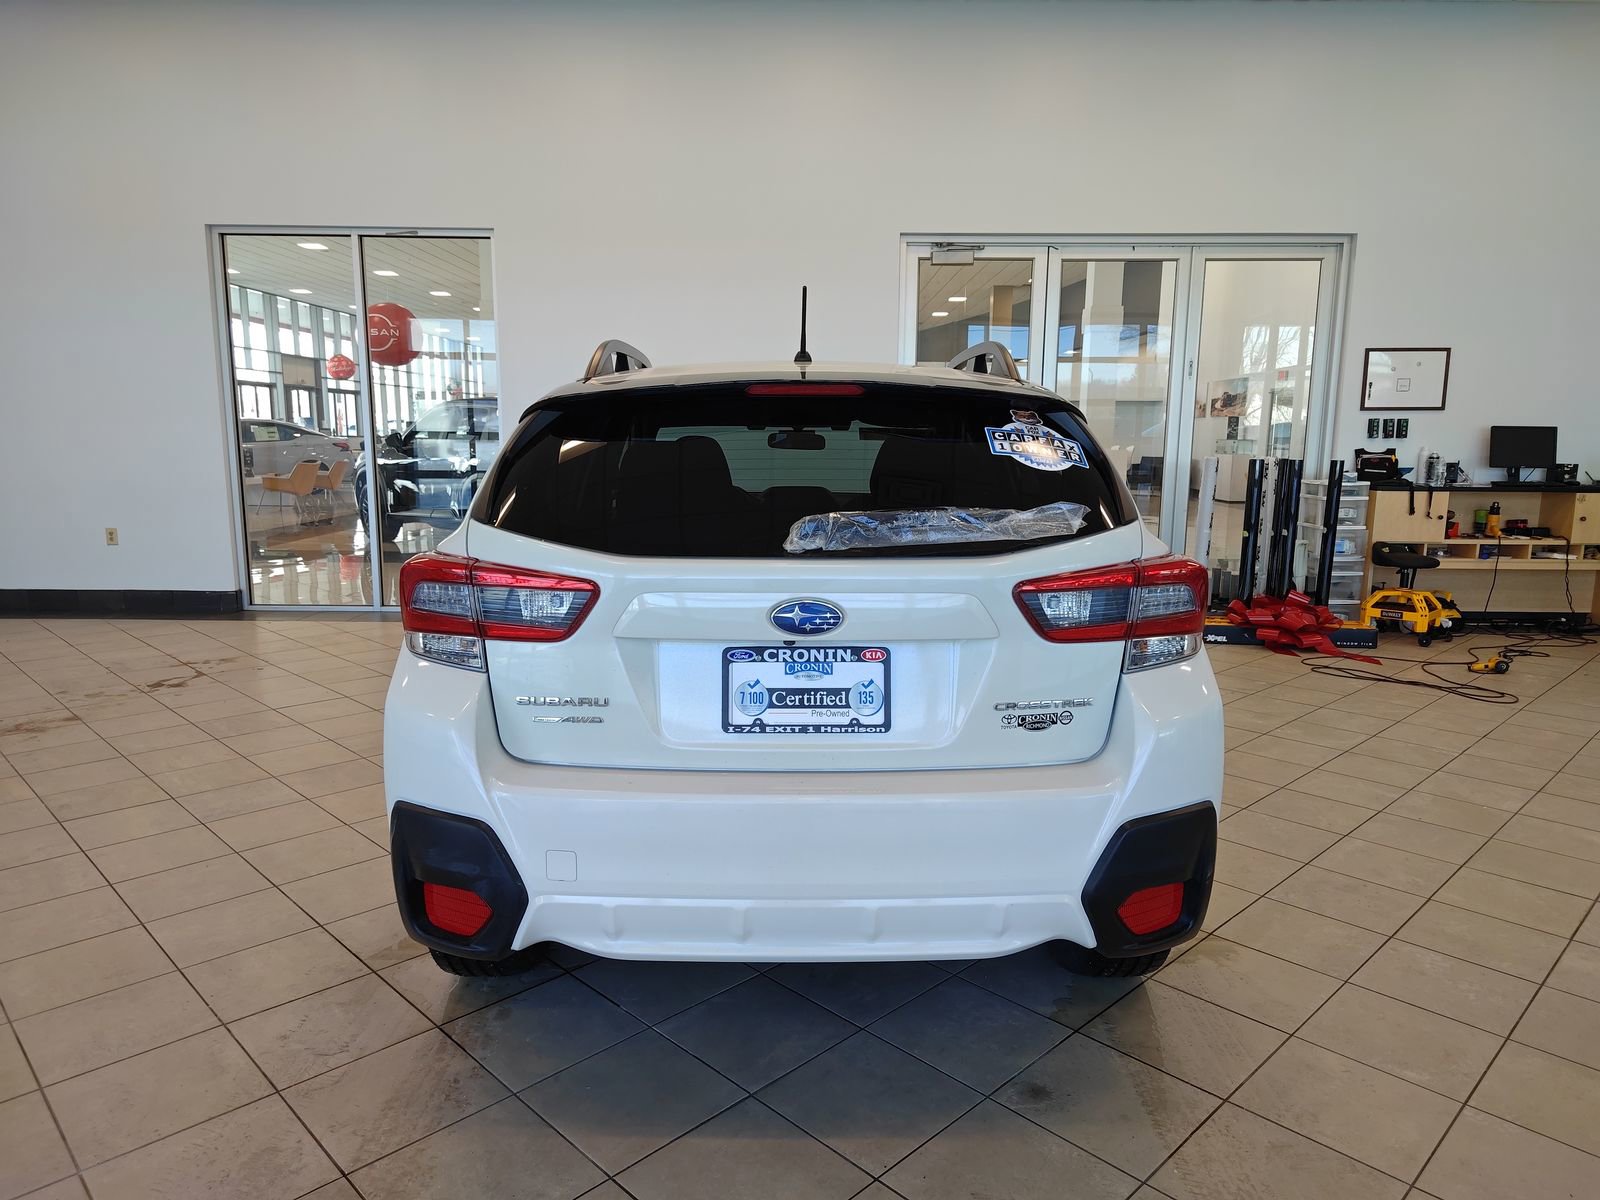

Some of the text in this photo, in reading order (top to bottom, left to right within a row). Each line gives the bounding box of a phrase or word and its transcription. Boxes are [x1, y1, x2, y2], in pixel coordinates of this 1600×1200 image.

[370, 328, 400, 337] SAN
[994, 432, 1077, 453] CARFAX
[998, 442, 1007, 451] 1
[1012, 444, 1081, 462] OWNER
[763, 649, 851, 662] CRONIN
[864, 651, 883, 659] KIA
[786, 662, 832, 674] CRONIN
[515, 696, 609, 707] SUBARU
[771, 691, 847, 706] Certified
[858, 691, 874, 705] 135
[993, 698, 1094, 711] CROSSTREK
[811, 709, 850, 718] Pre-Owned
[1018, 713, 1058, 724] CRONIN
